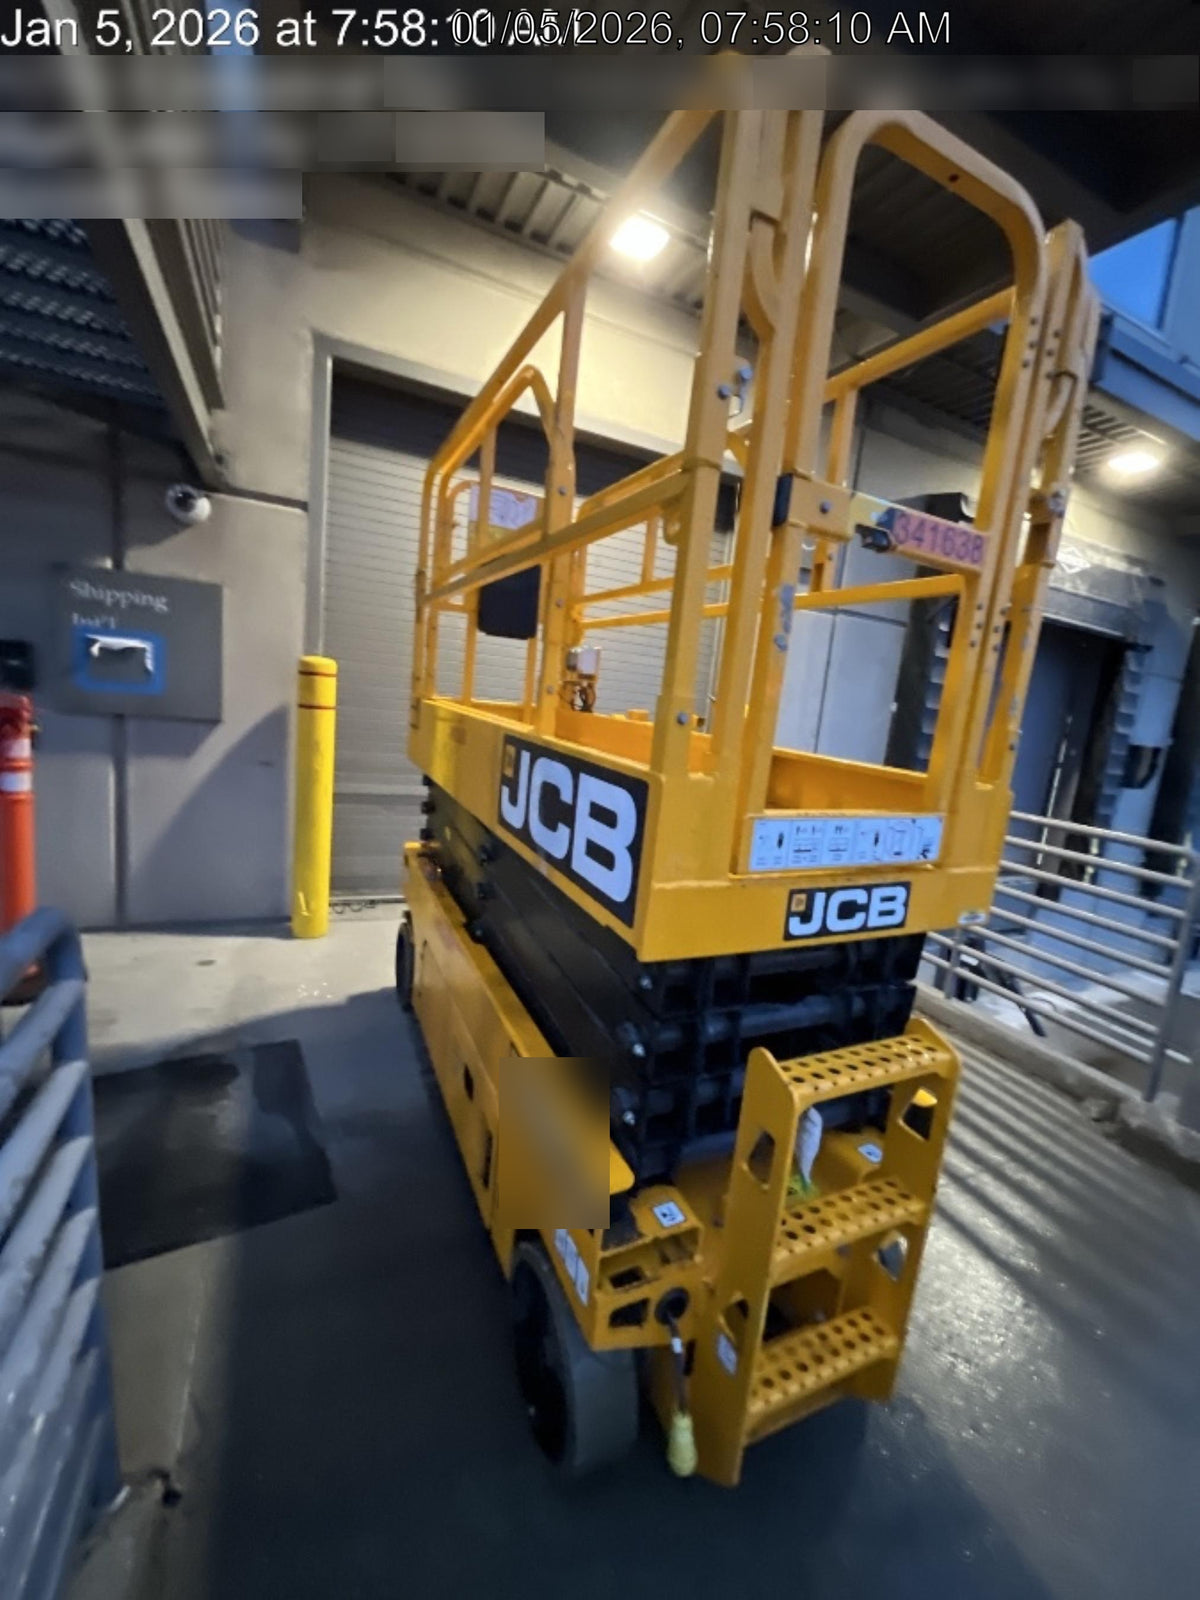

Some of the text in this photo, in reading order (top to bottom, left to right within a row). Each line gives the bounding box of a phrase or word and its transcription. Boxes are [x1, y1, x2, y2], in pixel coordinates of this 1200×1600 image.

[893, 510, 984, 564] 341638
[69, 579, 169, 614] Shipping
[500, 750, 638, 903] JCB
[788, 885, 908, 937] JCB
